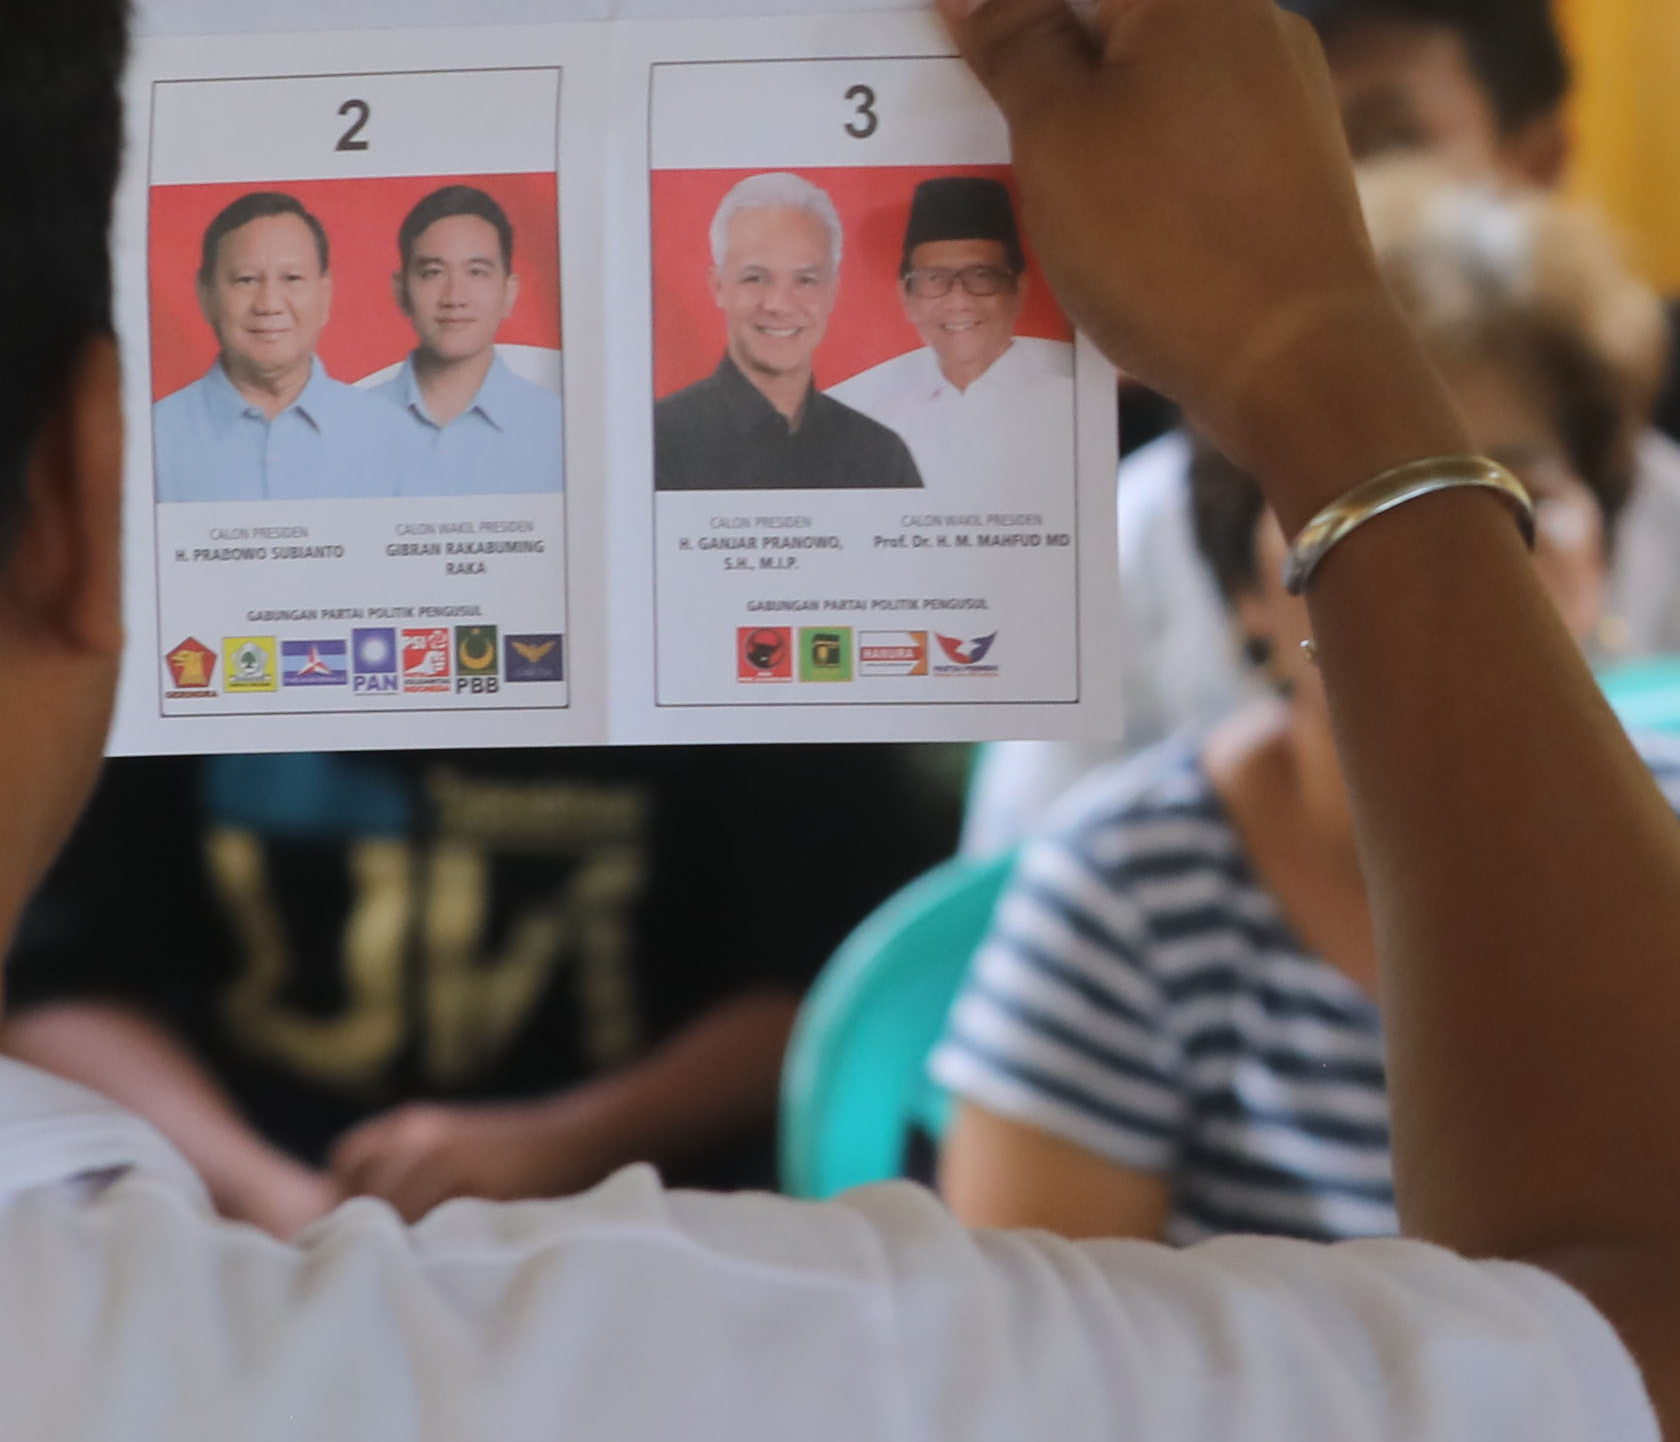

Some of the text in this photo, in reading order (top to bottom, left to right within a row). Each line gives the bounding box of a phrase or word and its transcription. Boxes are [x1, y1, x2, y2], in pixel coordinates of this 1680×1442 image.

[843, 84, 880, 140] 3
[335, 98, 372, 153] 2
[710, 516, 811, 529] CALON PRESIDEN
[901, 514, 942, 527] CALON
[679, 538, 693, 551] H.
[698, 537, 757, 551] GANJAR
[912, 535, 931, 548] Dr.
[937, 535, 950, 548] H.
[955, 534, 973, 547] M.
[977, 534, 1041, 548] MAHFUD
[1045, 533, 1070, 547] MD
[271, 545, 345, 560] SUBIANTO
[386, 540, 545, 557] GIBRAN RAKABUMING
[445, 562, 486, 575] RAKA
[747, 598, 988, 612] GABUNGAN PARTAI POLITIK PENGUSUL
[246, 604, 482, 622] GABUNGAN PARTAI POLITIK PENGUSUL
[353, 675, 398, 692] PAN
[456, 677, 499, 694] PBB
